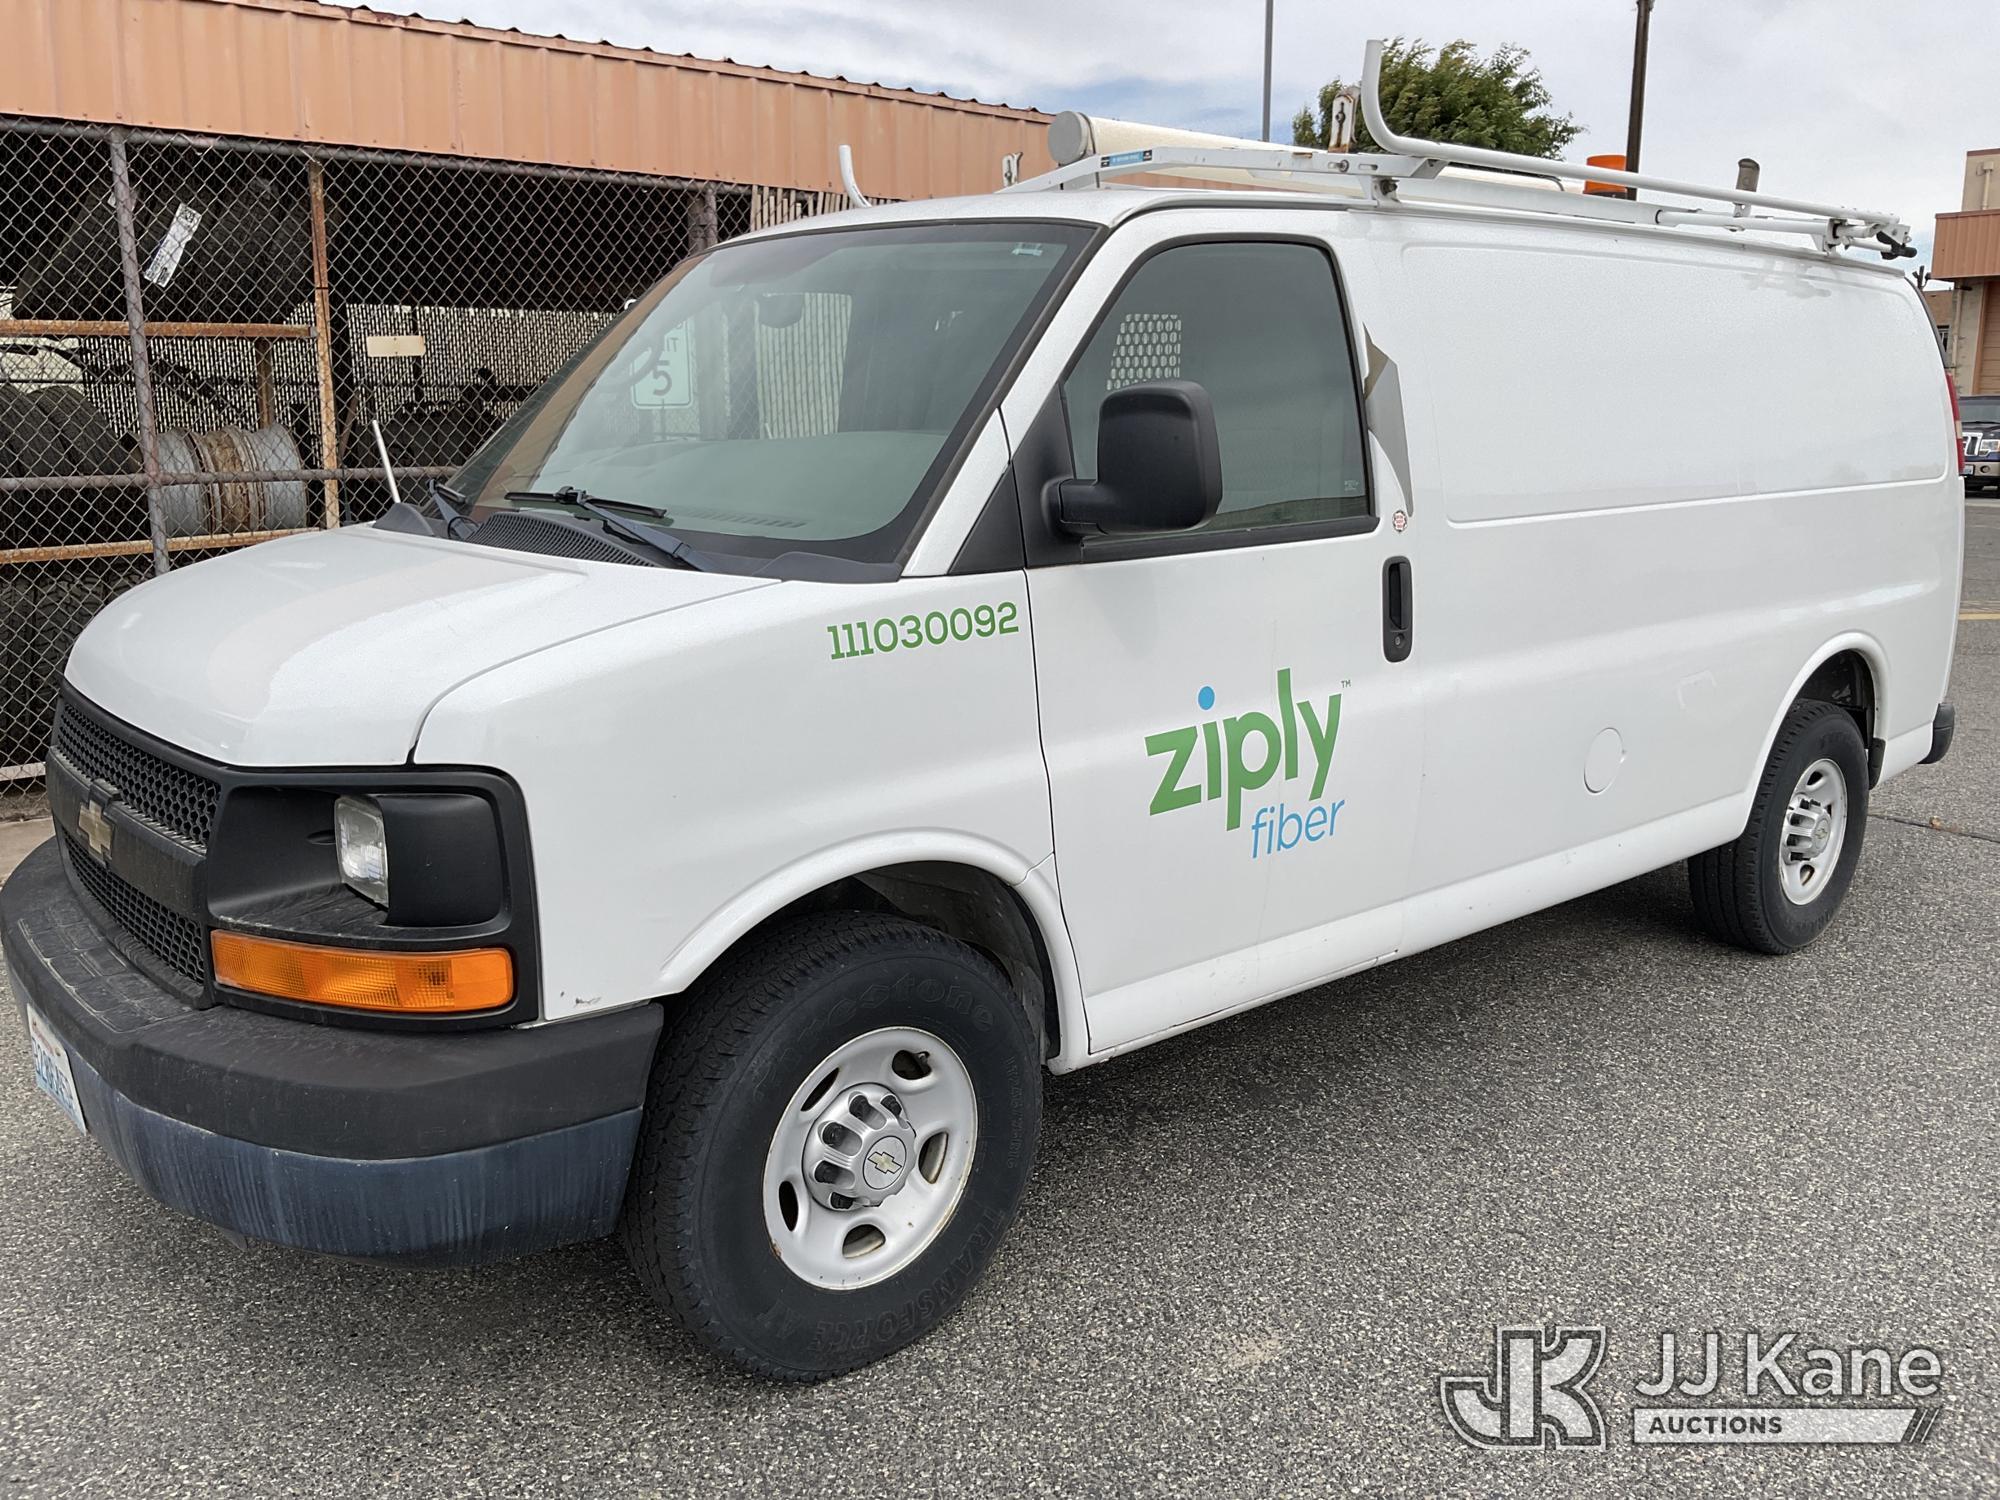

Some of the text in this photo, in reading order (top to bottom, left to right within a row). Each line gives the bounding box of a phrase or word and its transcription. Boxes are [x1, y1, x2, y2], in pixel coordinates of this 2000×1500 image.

[652, 360, 673, 396] 5
[827, 602, 1019, 660] 111030092
[1144, 668, 1342, 832] ziply
[1251, 799, 1345, 858] fiber
[807, 1205, 1007, 1353] TRANSFORCE
